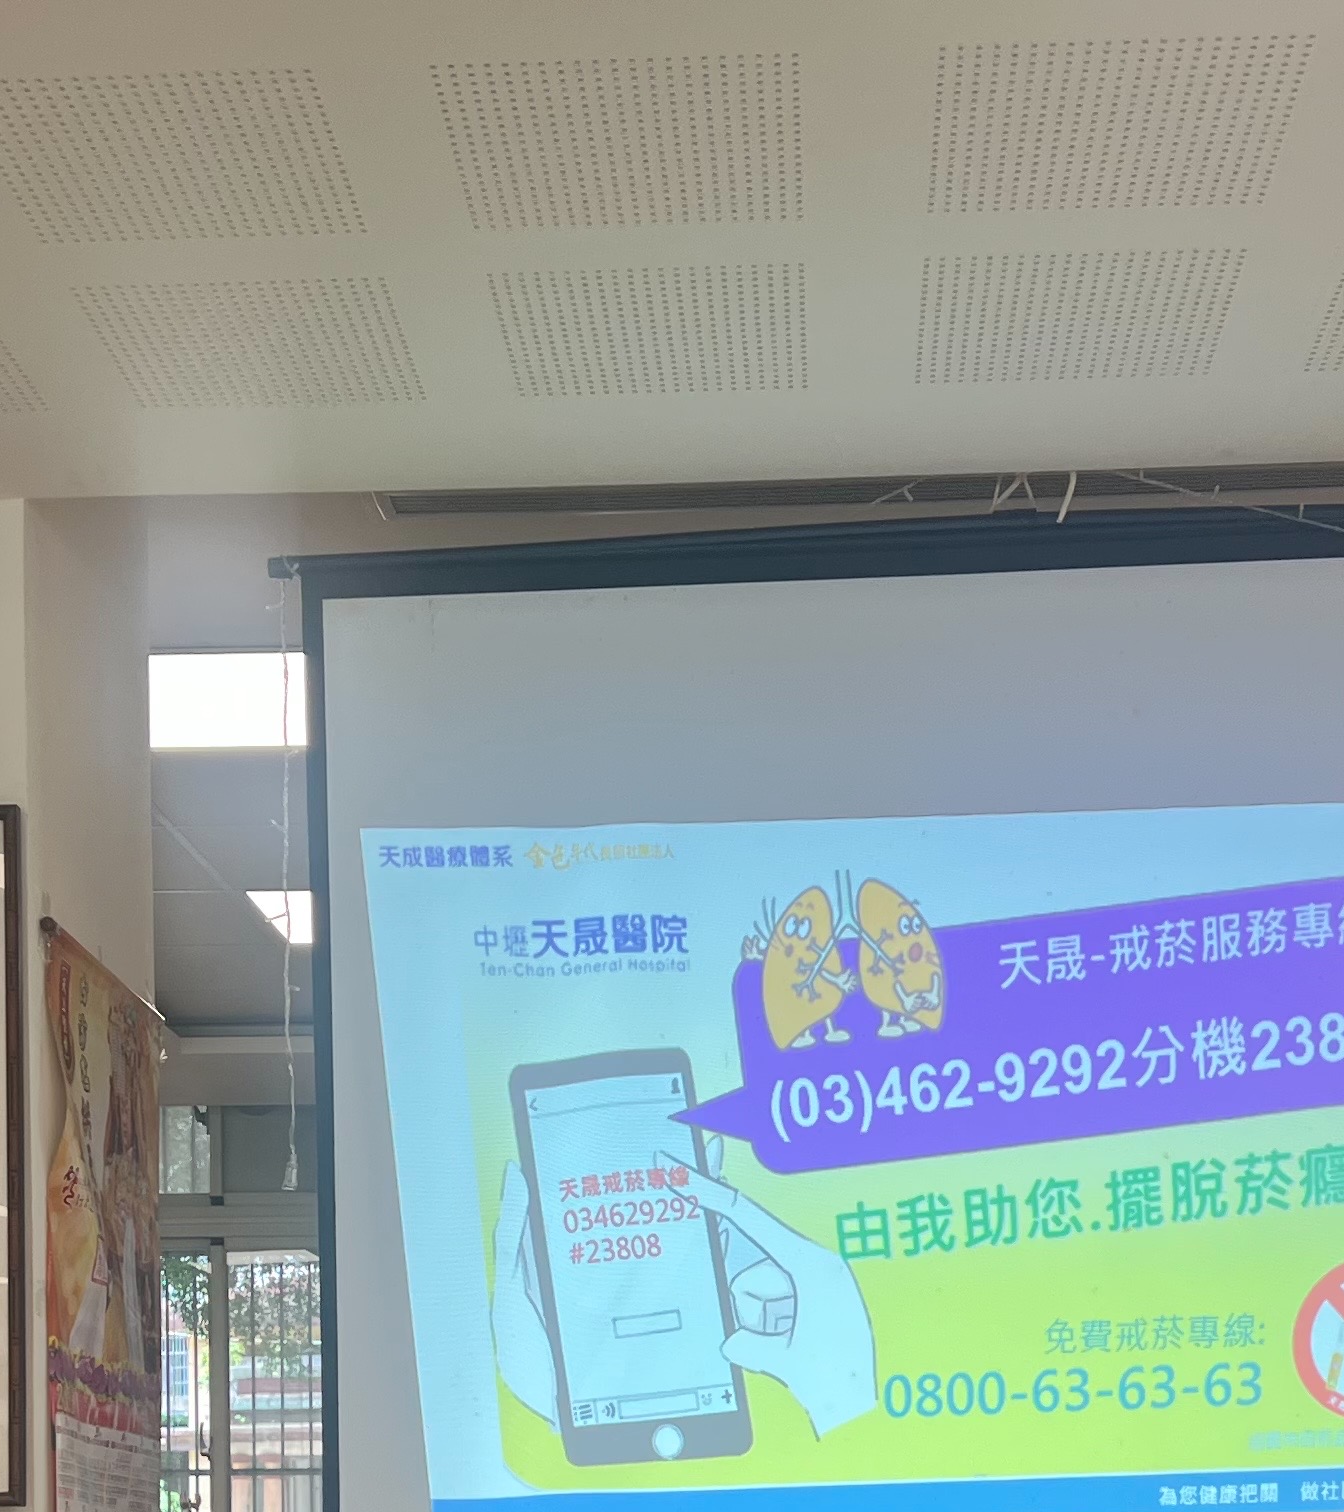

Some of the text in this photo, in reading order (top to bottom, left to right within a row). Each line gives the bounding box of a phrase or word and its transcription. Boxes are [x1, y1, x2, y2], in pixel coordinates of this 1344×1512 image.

[379, 844, 514, 869] 天成醫療體系
[479, 957, 691, 977] Ten-Chan General Hospital
[563, 1195, 701, 1234] 034629292
[569, 1233, 663, 1265] #23808
[884, 1361, 1263, 1420] 0800-63-63-63
[1159, 1482, 1279, 1506] 為您健康把關
